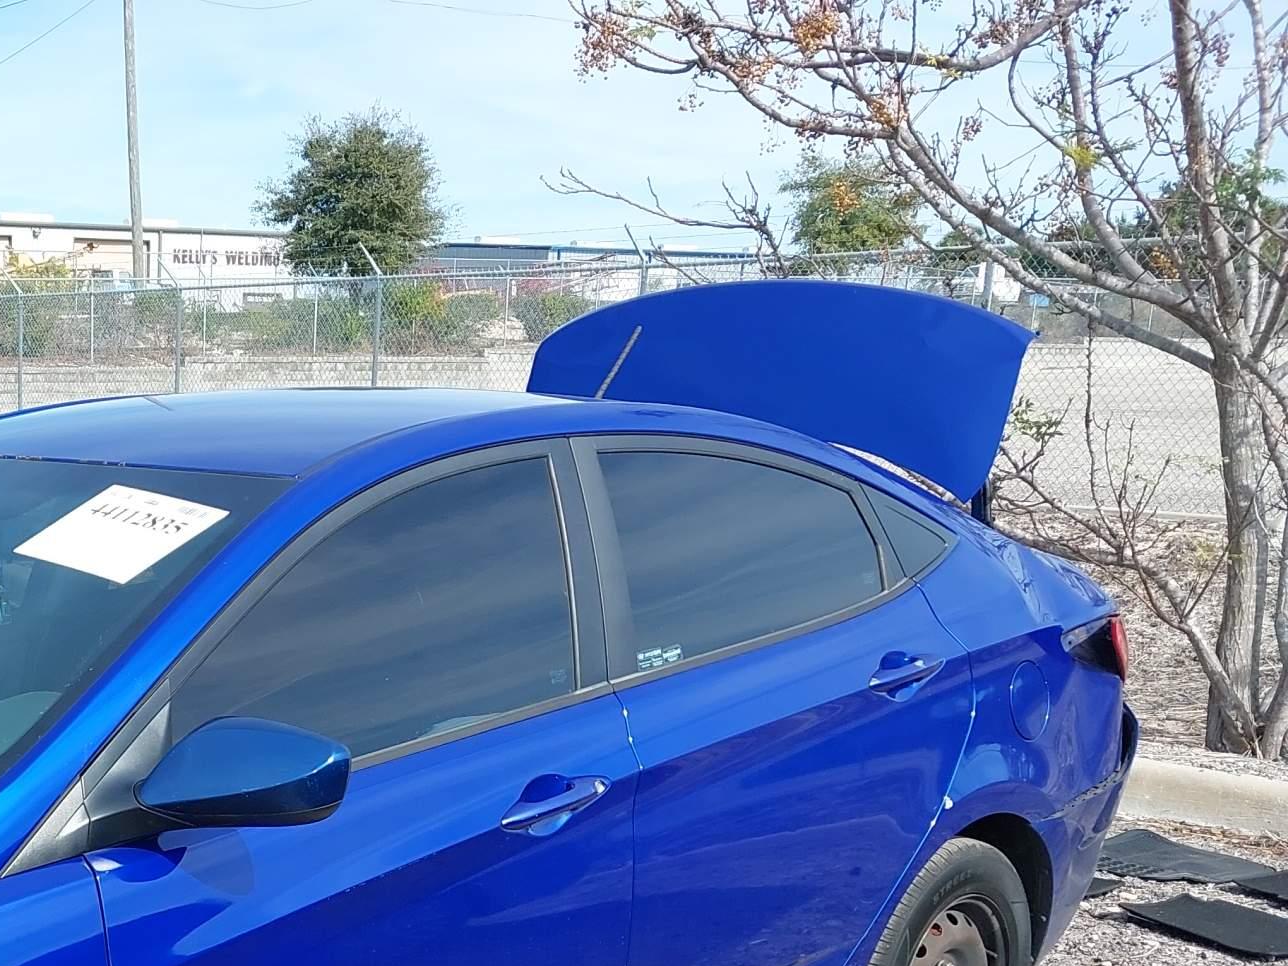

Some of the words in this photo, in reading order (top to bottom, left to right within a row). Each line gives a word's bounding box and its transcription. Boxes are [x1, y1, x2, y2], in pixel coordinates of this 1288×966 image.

[173, 249, 217, 265] KELLY'S
[225, 251, 280, 267] WELDING
[91, 503, 189, 535] 44112835
